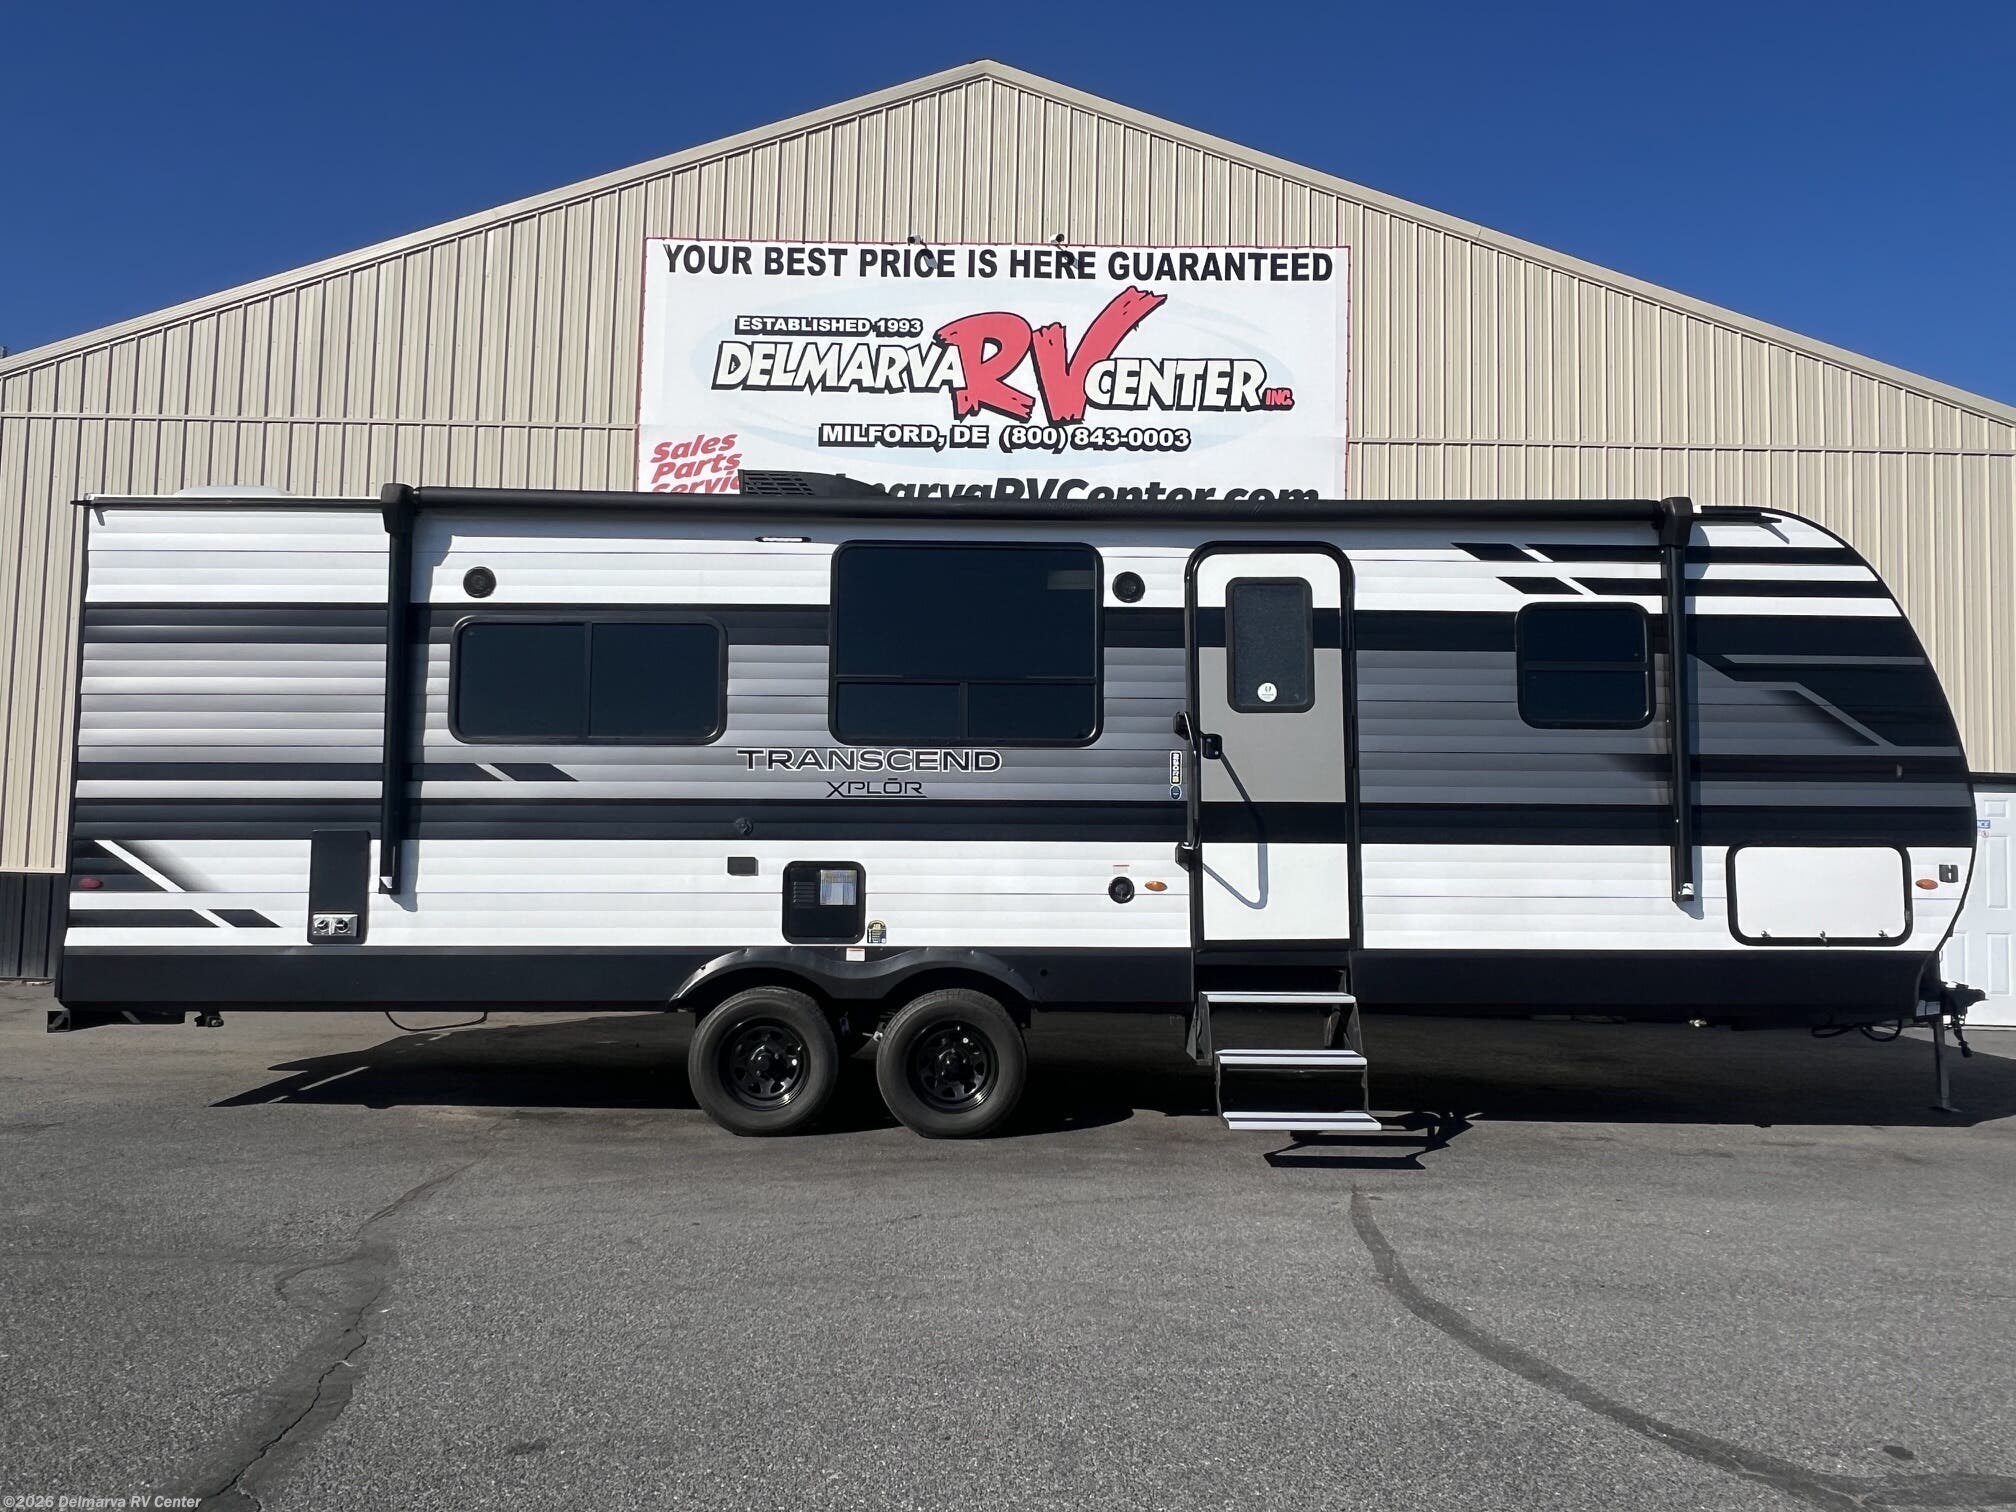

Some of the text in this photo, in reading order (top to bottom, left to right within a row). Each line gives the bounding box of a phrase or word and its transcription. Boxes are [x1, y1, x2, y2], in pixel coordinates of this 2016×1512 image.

[663, 244, 1333, 282] YOUR BEST PRICE IS HERE GUARANTEED
[736, 315, 923, 337] ESTABLISHED 1993
[711, 285, 1295, 425] DELMARVA RV CENTER INC.
[650, 433, 738, 463] Sales
[818, 423, 1191, 454] MILFORD, DE (800) 843-0003
[651, 453, 742, 484] Parts
[652, 471, 740, 493] rvic
[737, 748, 1003, 773] TRANSCEND
[826, 777, 928, 799] XPLŌR
